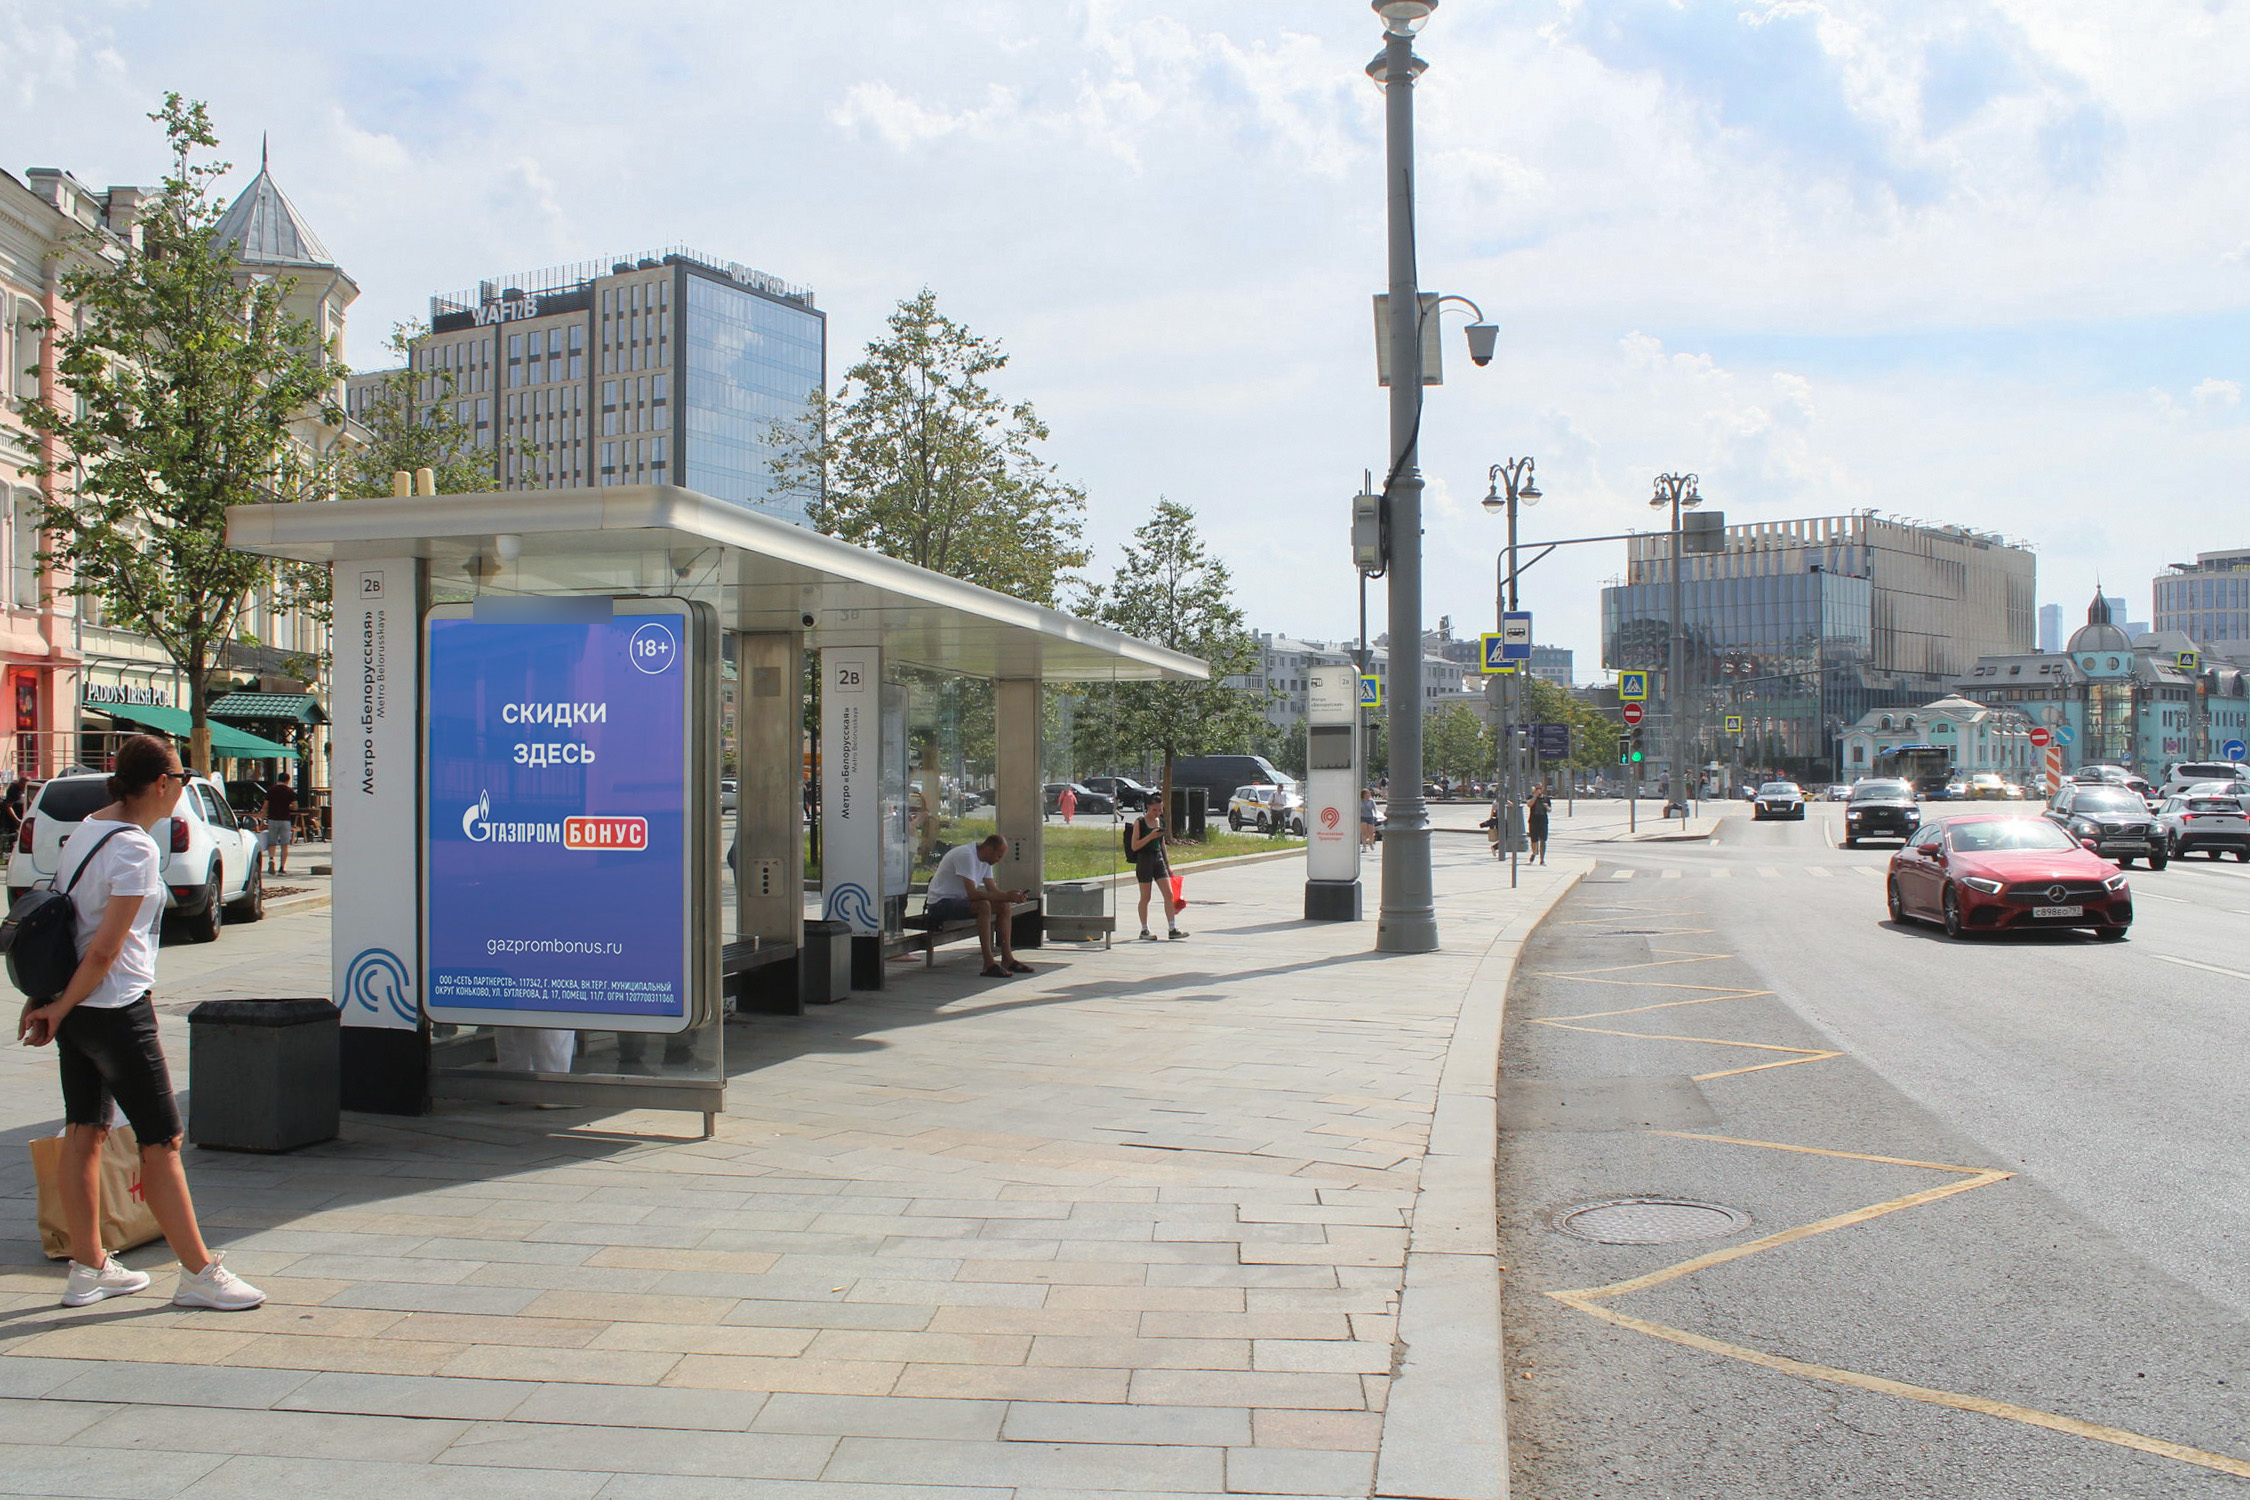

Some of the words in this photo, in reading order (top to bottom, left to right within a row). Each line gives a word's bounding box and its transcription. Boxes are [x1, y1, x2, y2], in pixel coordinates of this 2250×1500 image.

[376, 610, 387, 681] Belorusskaya
[636, 639, 669, 657] 18+
[361, 611, 376, 734] «Белорусская»
[87, 681, 126, 704] PADDY'S
[127, 686, 152, 705] IRISH
[153, 687, 171, 706] PUB
[377, 684, 386, 719] Metro
[502, 702, 607, 728] СКИДКИ
[513, 743, 596, 769] ЗДЕСЬ
[841, 707, 851, 783] «Белорусская»
[361, 739, 376, 795] Метро
[841, 785, 851, 819] Метро
[569, 823, 642, 844] БОНУС
[486, 938, 623, 955] gazprombonus.ru
[435, 986, 455, 995] ОКРУГ
[455, 986, 491, 997] КОНЬКОВО,
[492, 987, 503, 997] УЛ.
[503, 988, 541, 999] БУТЛЕРОВА,
[542, 989, 549, 1000] Д.
[551, 990, 561, 1000] 17,
[562, 990, 588, 1001] ПОМЕЩ.
[607, 991, 624, 1001] ОГРН
[439, 975, 453, 985] ООО
[453, 976, 473, 986] «СЕТЬ
[519, 978, 543, 988] 117342,
[544, 978, 550, 988] Г.
[551, 979, 580, 990] МОСКВА,
[611, 981, 672, 992] МУНИЦИПАЛЬНЫЙ
